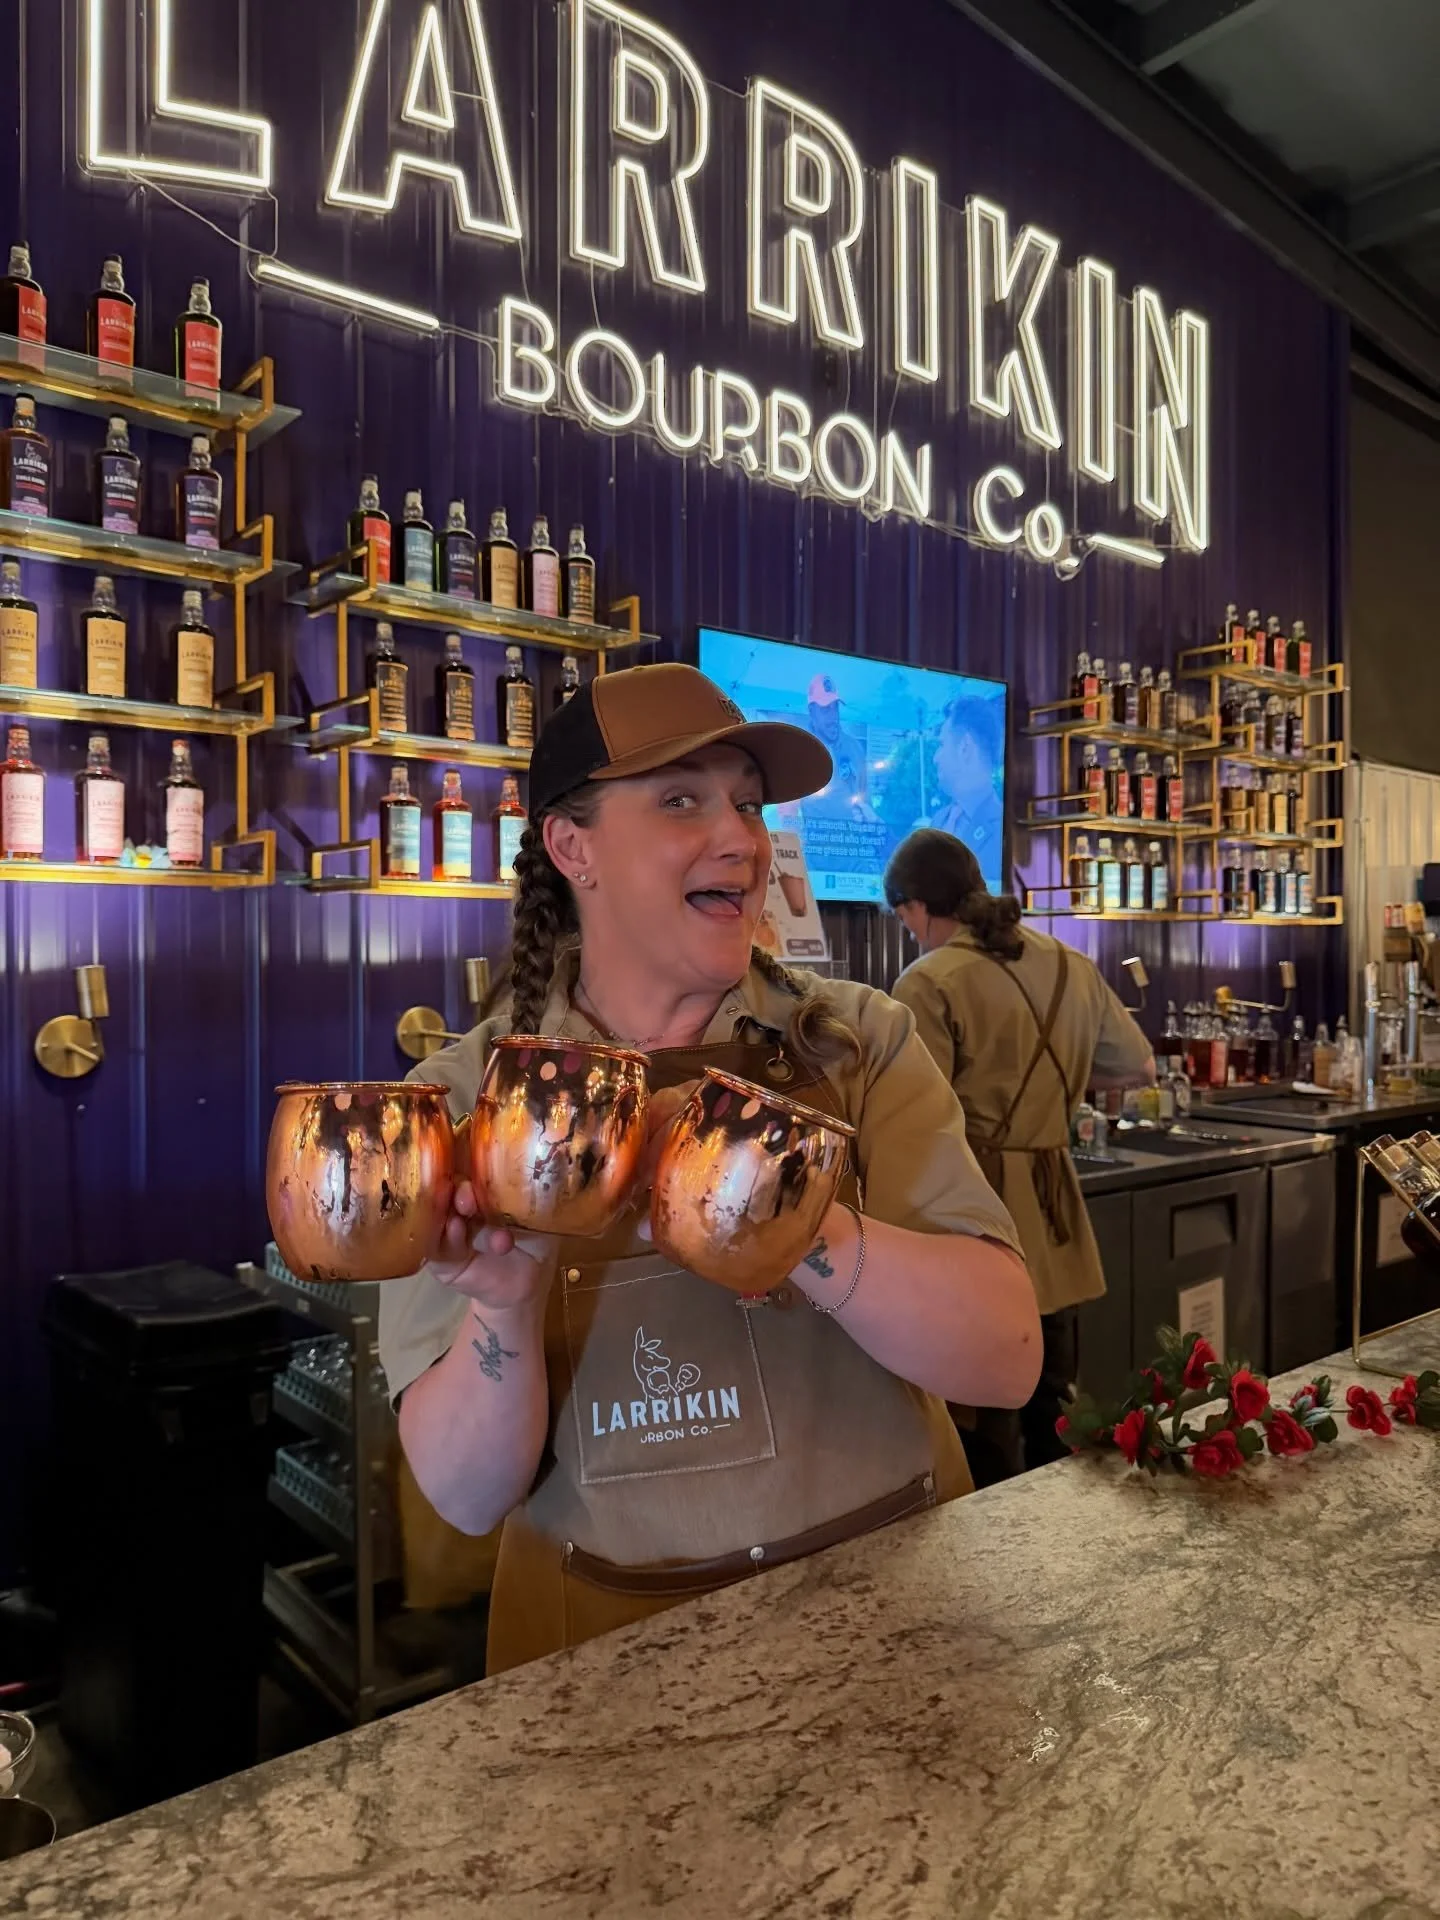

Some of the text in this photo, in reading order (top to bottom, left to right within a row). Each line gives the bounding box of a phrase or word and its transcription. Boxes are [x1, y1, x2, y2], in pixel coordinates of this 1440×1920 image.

[82, 0, 1211, 553] LARRIKIN
[497, 294, 1081, 570] BOURBON Co.
[776, 848, 799, 859] TRACK
[592, 1386, 741, 1436] LARRIKIN
[690, 1424, 712, 1436] Co.
